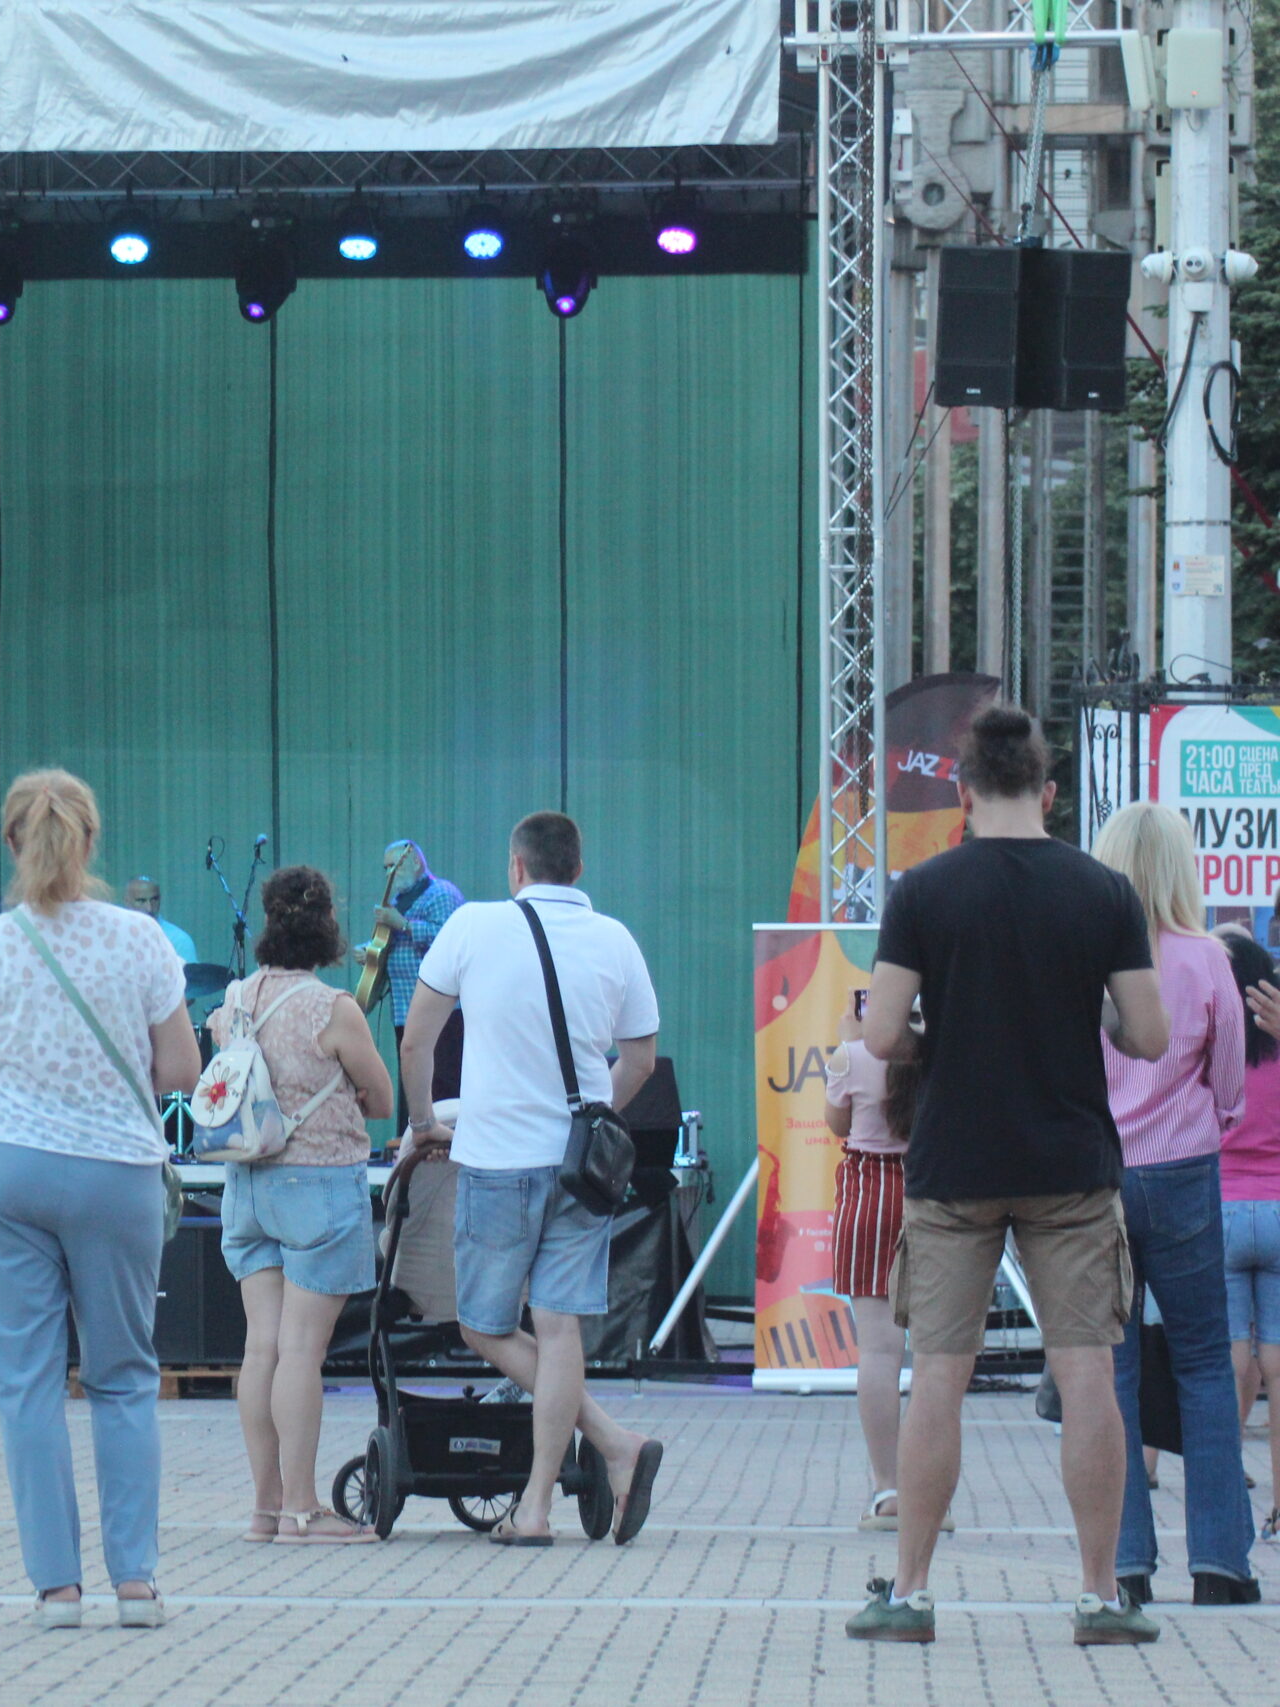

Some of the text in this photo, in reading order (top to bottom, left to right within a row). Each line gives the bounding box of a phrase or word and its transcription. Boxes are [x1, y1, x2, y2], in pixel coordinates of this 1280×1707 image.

[1186, 745, 1235, 769] 21:00
[1239, 746, 1279, 763] СЦЕНА
[1186, 770, 1234, 794] ЧАСА
[1239, 763, 1272, 780] ПРЕД
[1194, 855, 1280, 896] РОГР
[767, 1046, 838, 1093] JA
